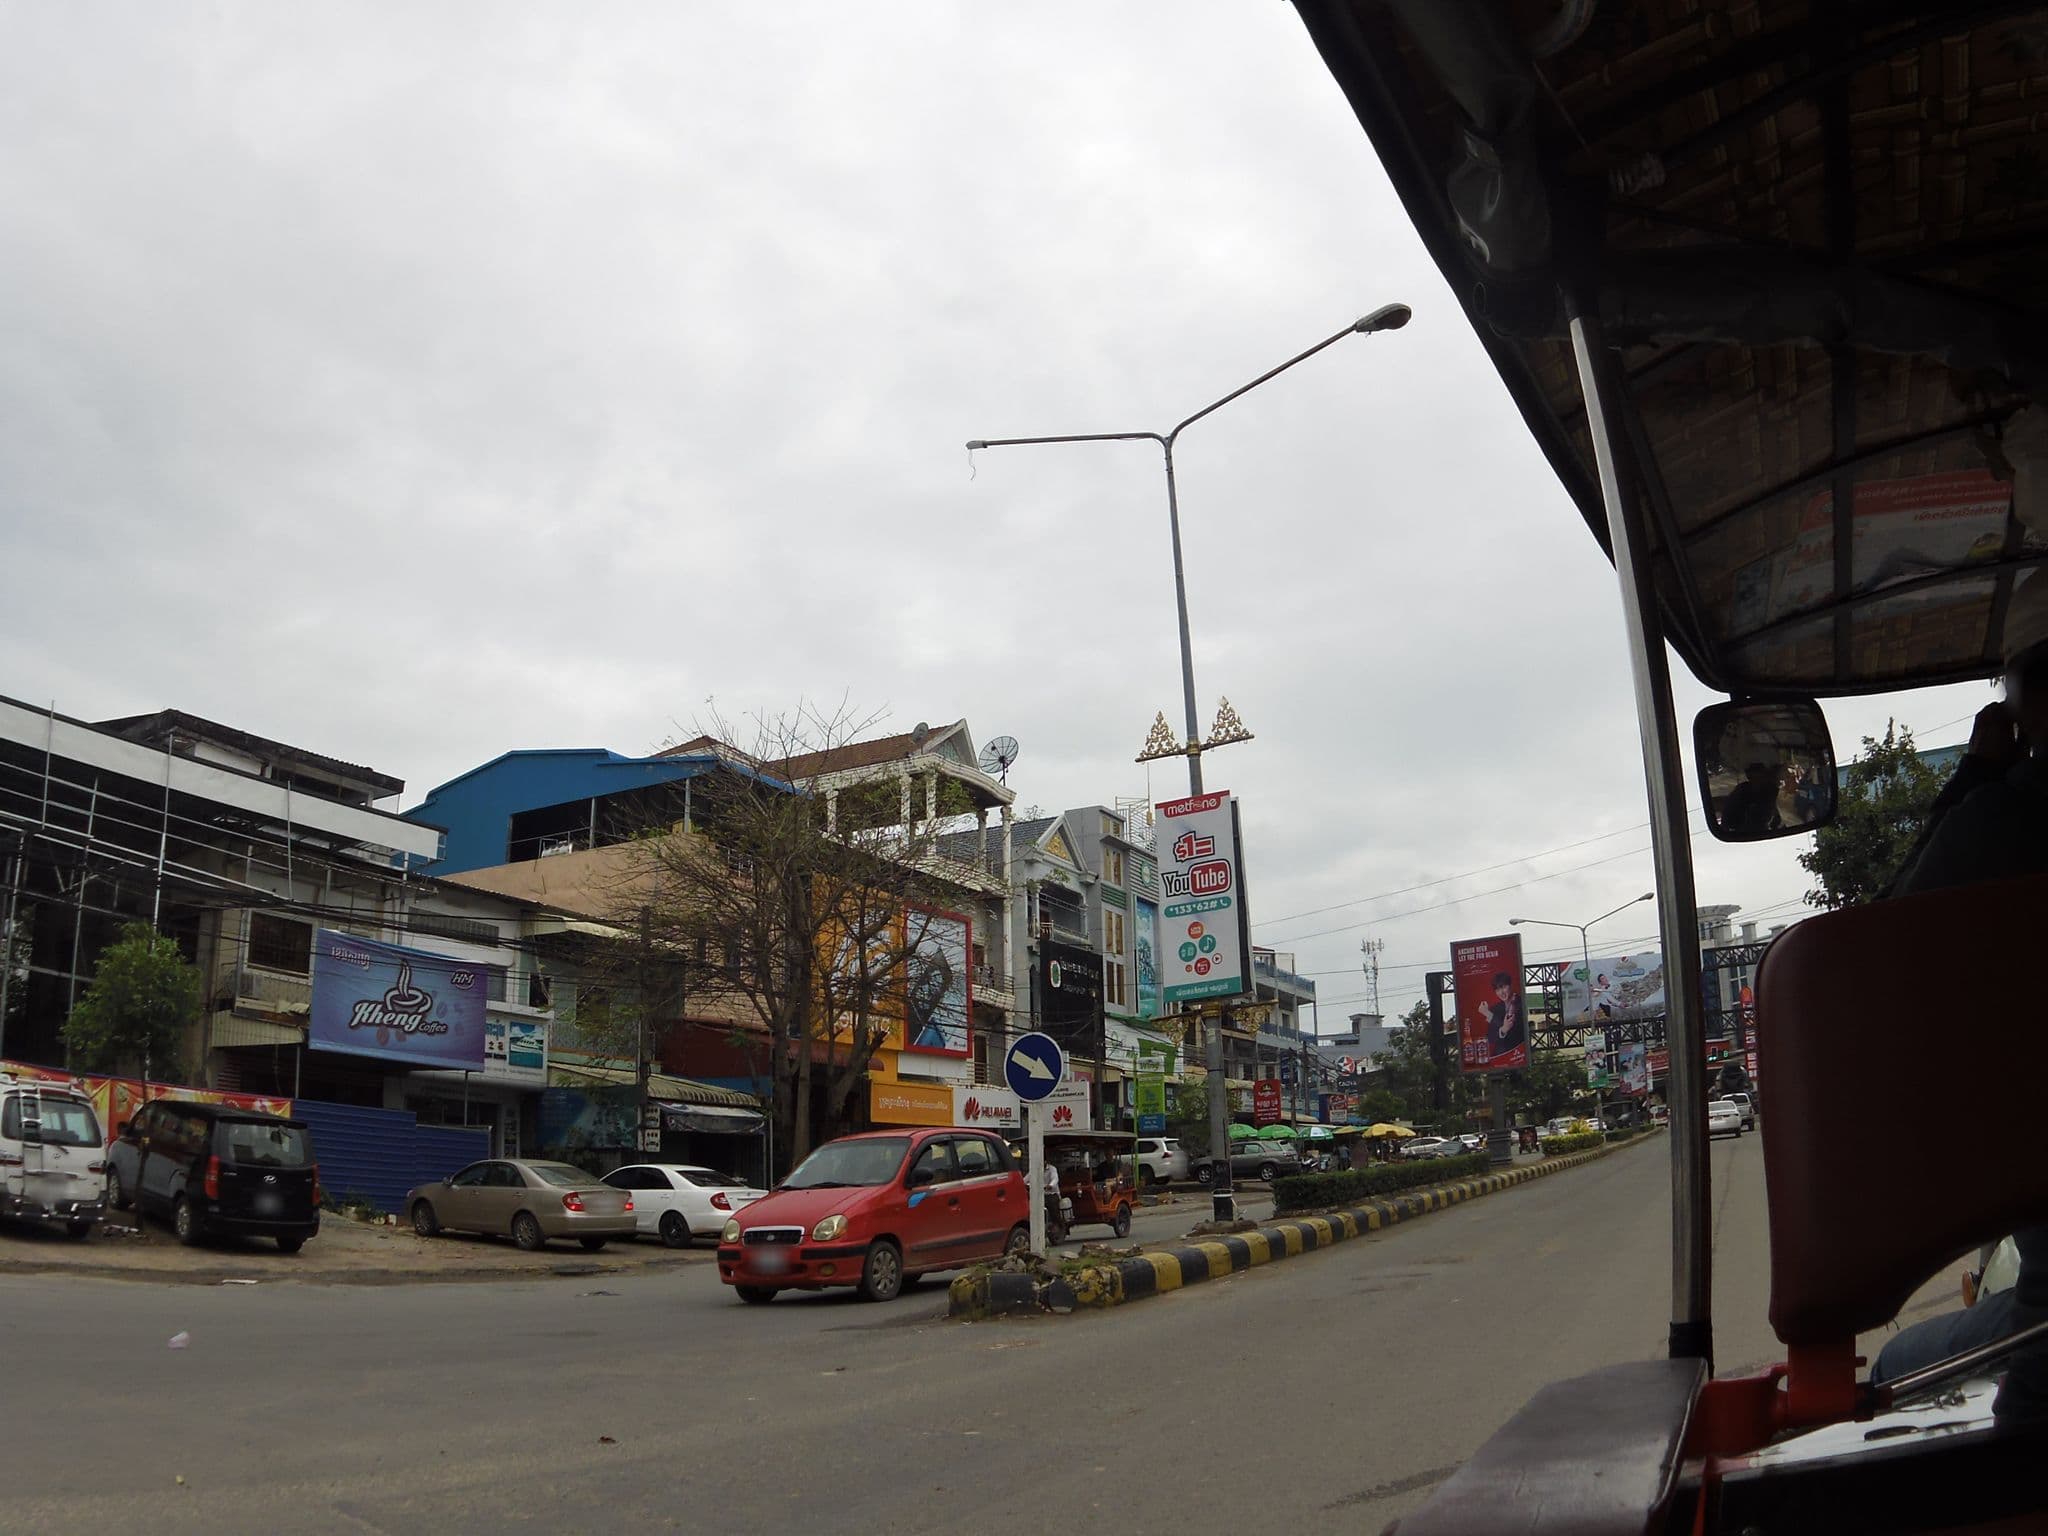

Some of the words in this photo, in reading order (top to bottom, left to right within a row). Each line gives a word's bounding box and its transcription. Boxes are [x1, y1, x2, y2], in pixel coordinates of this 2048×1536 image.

[1166, 798, 1217, 815] metfone
[1163, 866, 1227, 895] YouTube
[452, 970, 474, 986] HM
[351, 1002, 423, 1032] Kheng
[419, 1022, 448, 1033] Coffee
[981, 1106, 1012, 1118] HUAWEI
